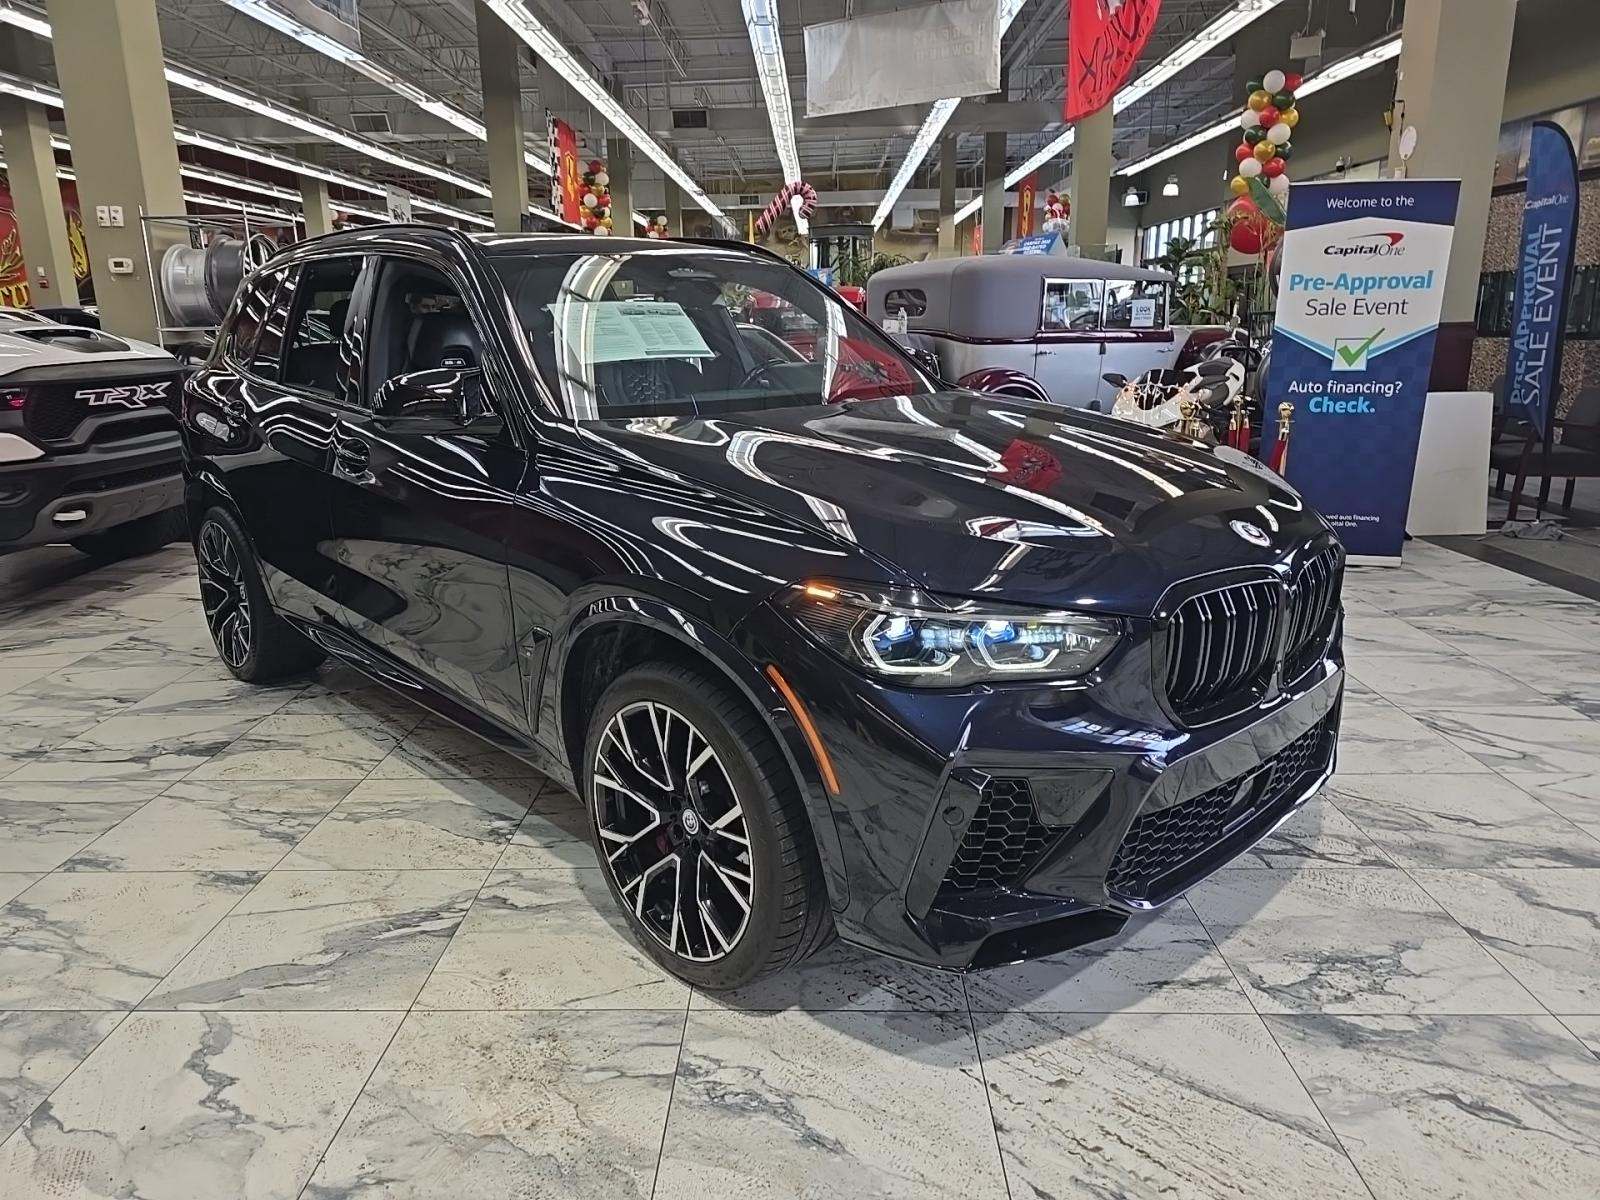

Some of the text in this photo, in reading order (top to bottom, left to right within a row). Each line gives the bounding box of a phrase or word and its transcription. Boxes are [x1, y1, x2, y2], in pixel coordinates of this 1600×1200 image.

[1326, 195, 1415, 209] Welcome to the
[1289, 270, 1434, 295] Pre-Approval
[1304, 298, 1409, 316] Sale Event
[1510, 224, 1543, 405] PRE-APPROVAL
[1521, 223, 1563, 407] SALE EVENT
[74, 381, 172, 409] TRX
[1288, 380, 1403, 397] Auto financing?
[1308, 397, 1376, 414] Check.
[1353, 514, 1380, 523] financing
